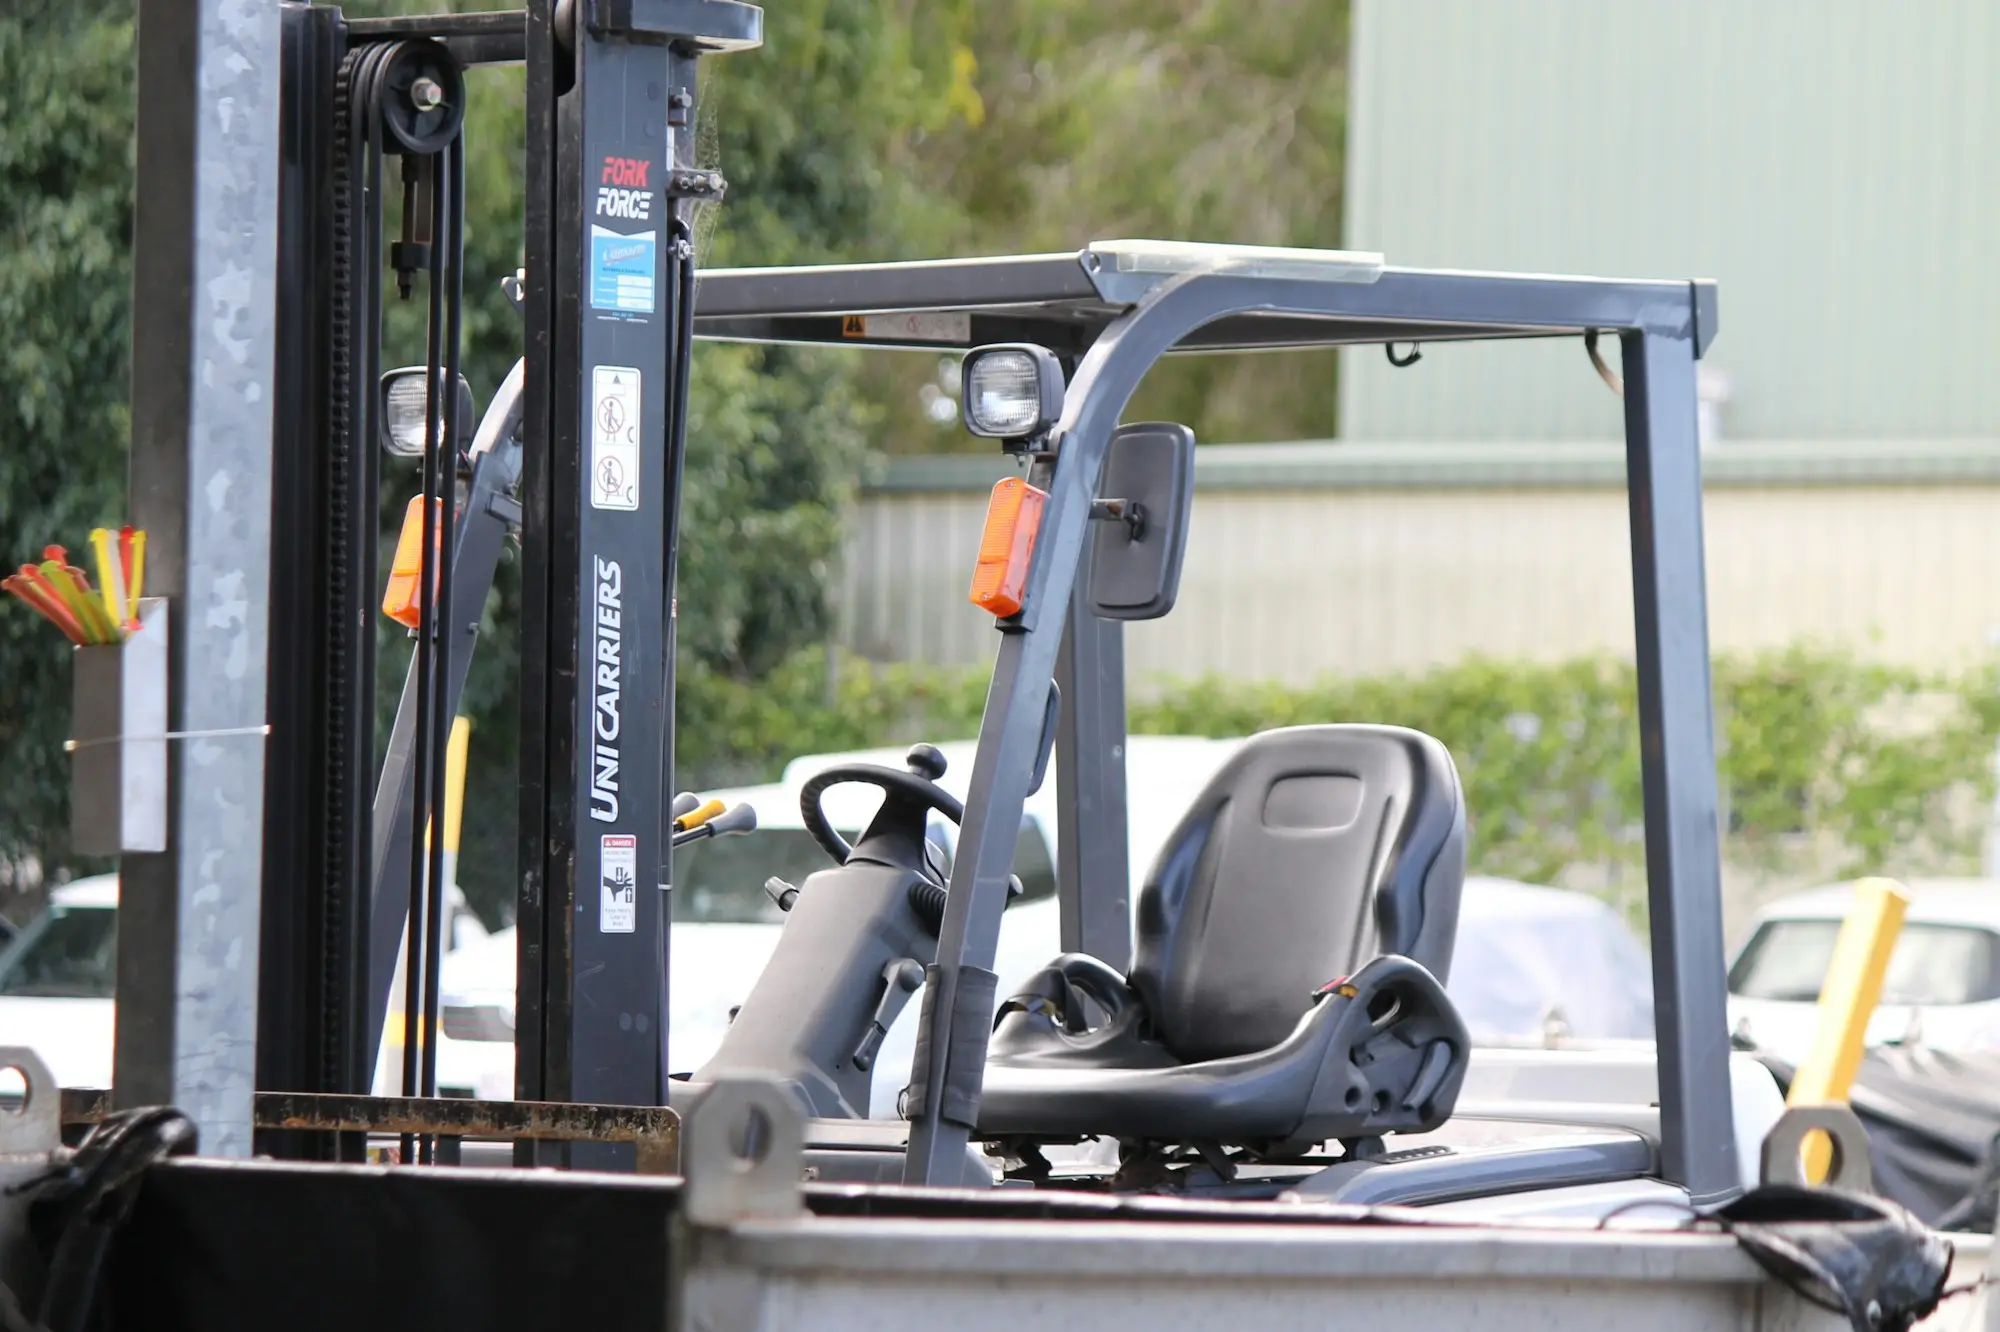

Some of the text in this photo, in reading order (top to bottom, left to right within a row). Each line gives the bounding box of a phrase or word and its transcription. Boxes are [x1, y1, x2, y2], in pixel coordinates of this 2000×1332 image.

[602, 157, 650, 188] FORK
[596, 187, 652, 220] FORCE
[591, 554, 621, 823] UNICARRIERS
